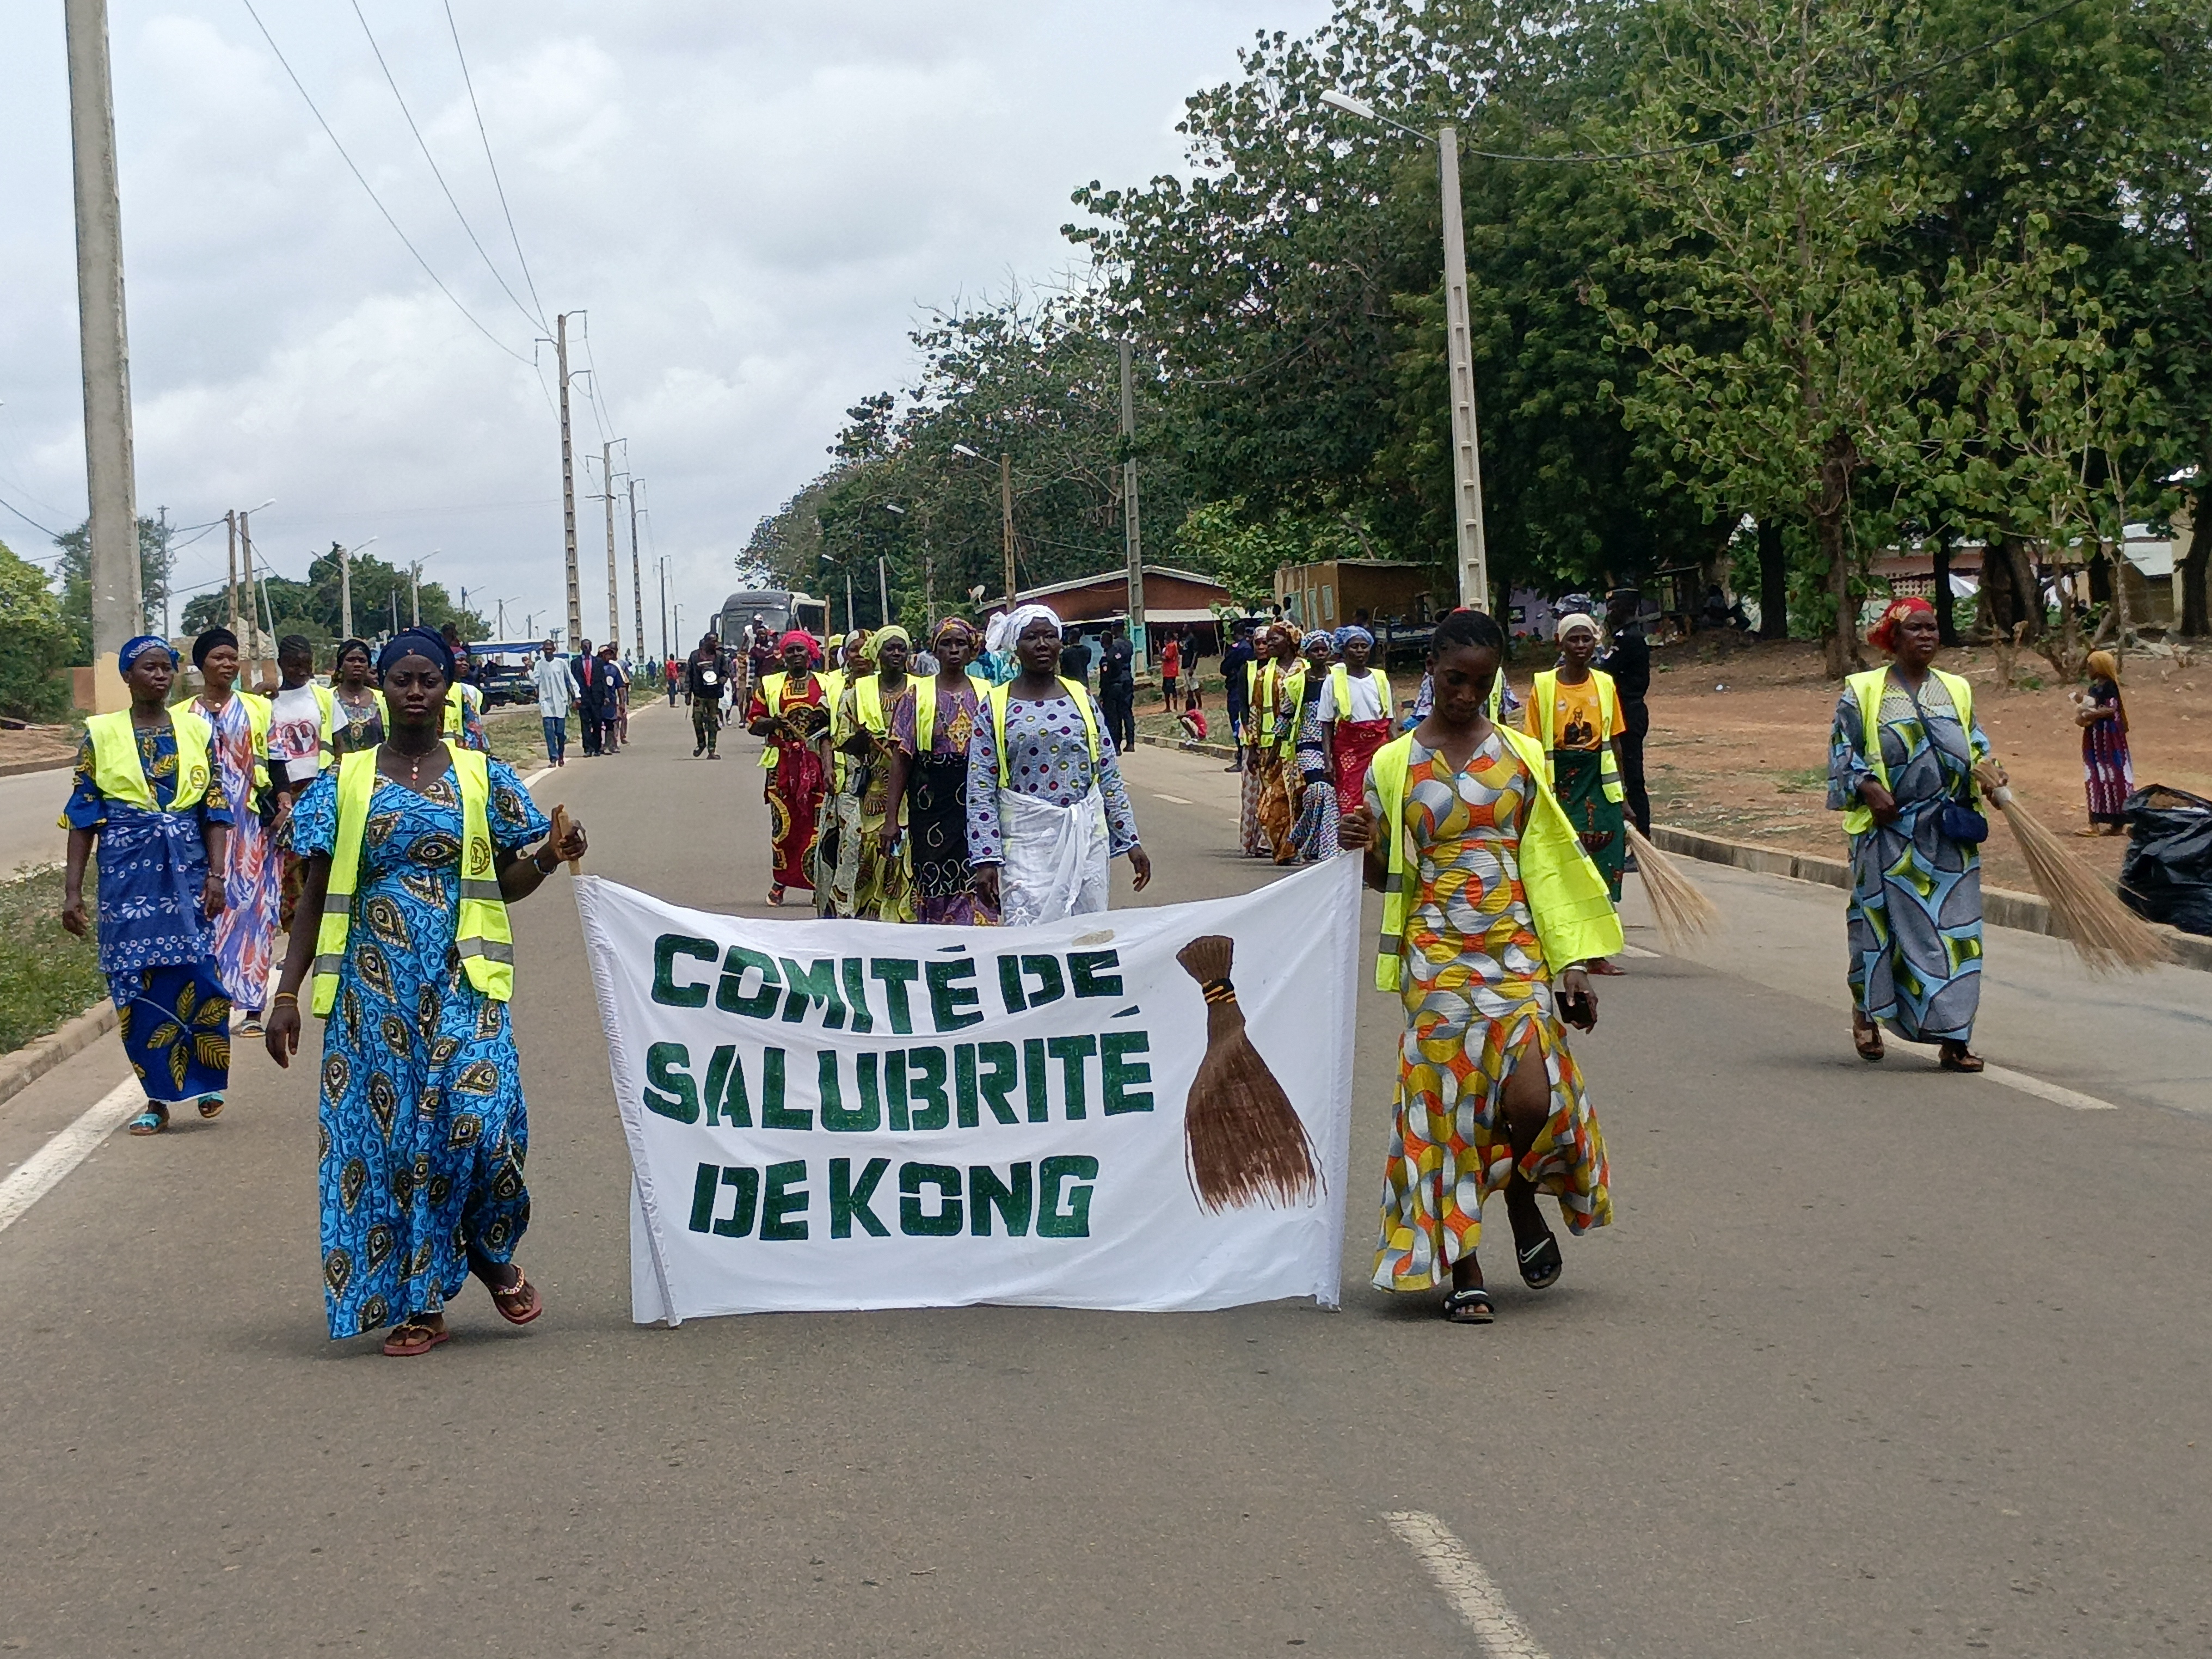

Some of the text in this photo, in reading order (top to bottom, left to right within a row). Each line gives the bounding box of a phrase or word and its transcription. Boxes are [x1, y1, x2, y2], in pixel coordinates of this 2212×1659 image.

[652, 932, 1123, 1035] COMITÉ DE
[642, 1004, 1155, 1132] SALUBRITÉ
[688, 1154, 1100, 1242] DE KONG
